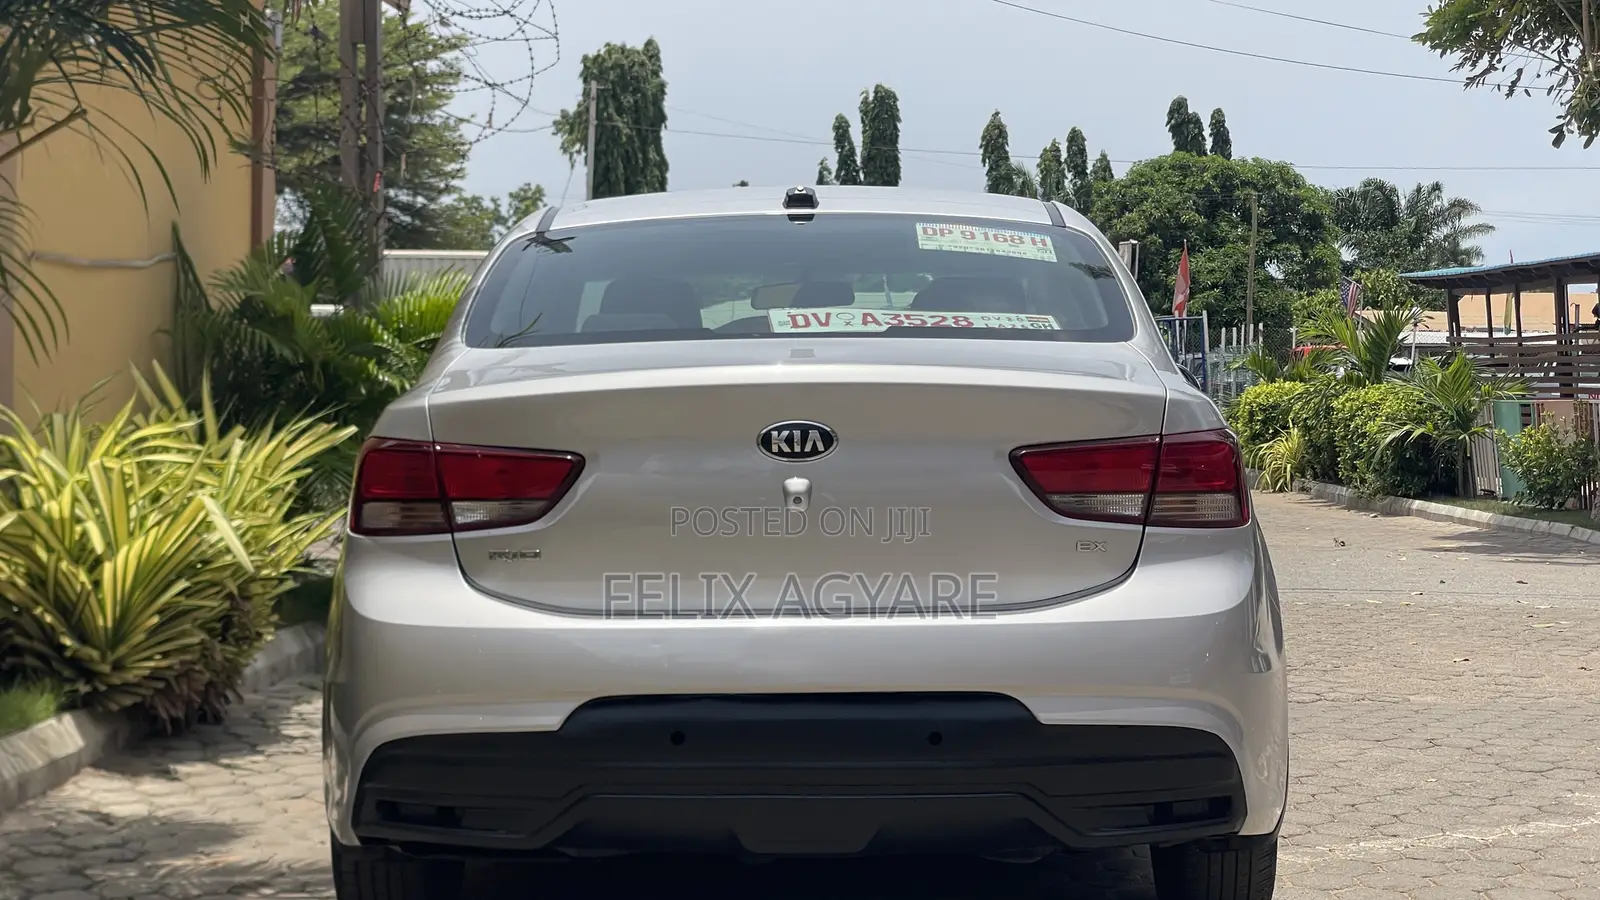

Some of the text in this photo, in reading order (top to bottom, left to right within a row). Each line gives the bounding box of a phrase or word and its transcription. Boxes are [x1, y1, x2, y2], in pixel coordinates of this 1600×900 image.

[921, 226, 1048, 247] DP 9168 H
[788, 312, 832, 329] DV
[861, 312, 975, 329] A3528
[770, 429, 825, 453] KIA
[1075, 540, 1108, 553] EX
